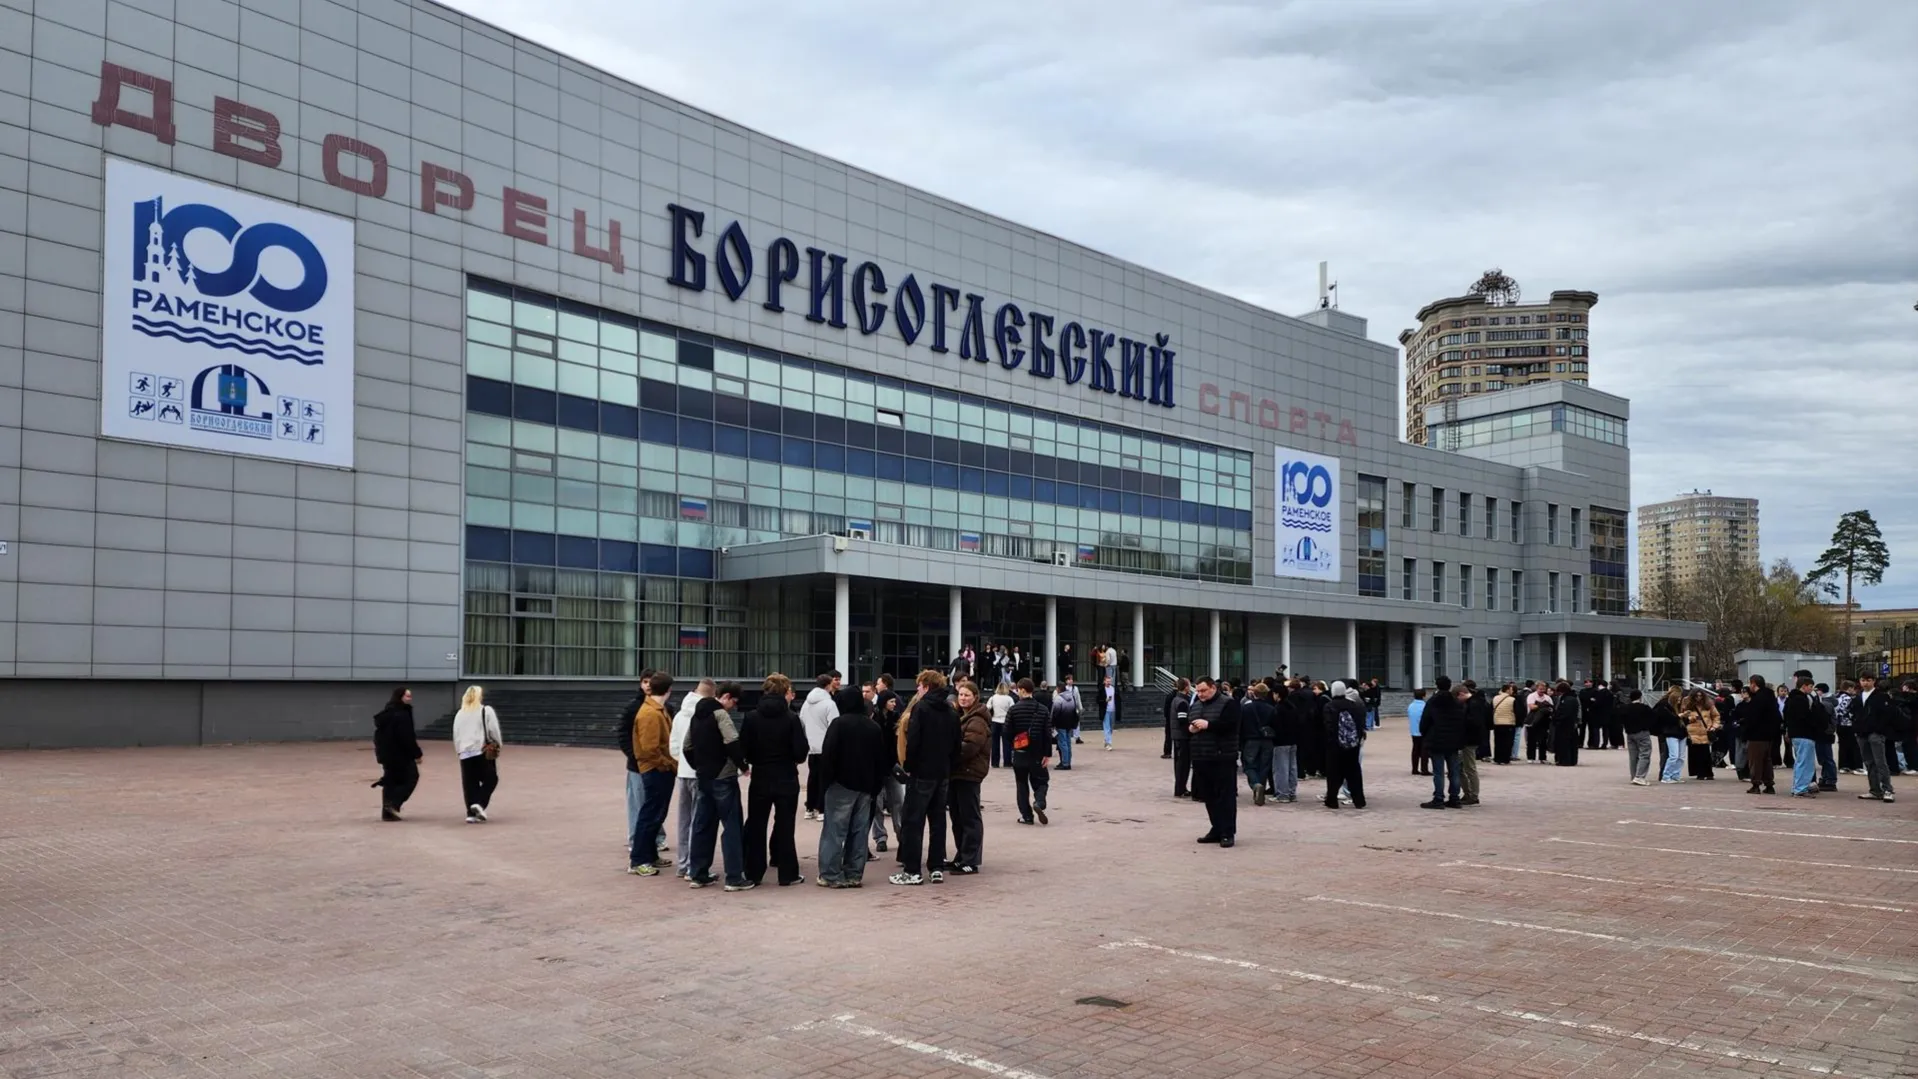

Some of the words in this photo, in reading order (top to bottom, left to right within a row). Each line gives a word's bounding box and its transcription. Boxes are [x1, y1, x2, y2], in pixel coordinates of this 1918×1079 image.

[91, 60, 625, 274] ДВОРЕЦ
[133, 195, 328, 312] 100
[132, 287, 325, 345] РАМЕНСКОЕ
[667, 203, 1176, 408] БОРИСОГЛЕБСКИЙ
[1199, 382, 1358, 447] СПОРТА
[1281, 460, 1333, 508] 100
[1281, 505, 1332, 522] РАМЕНСКОЕ
